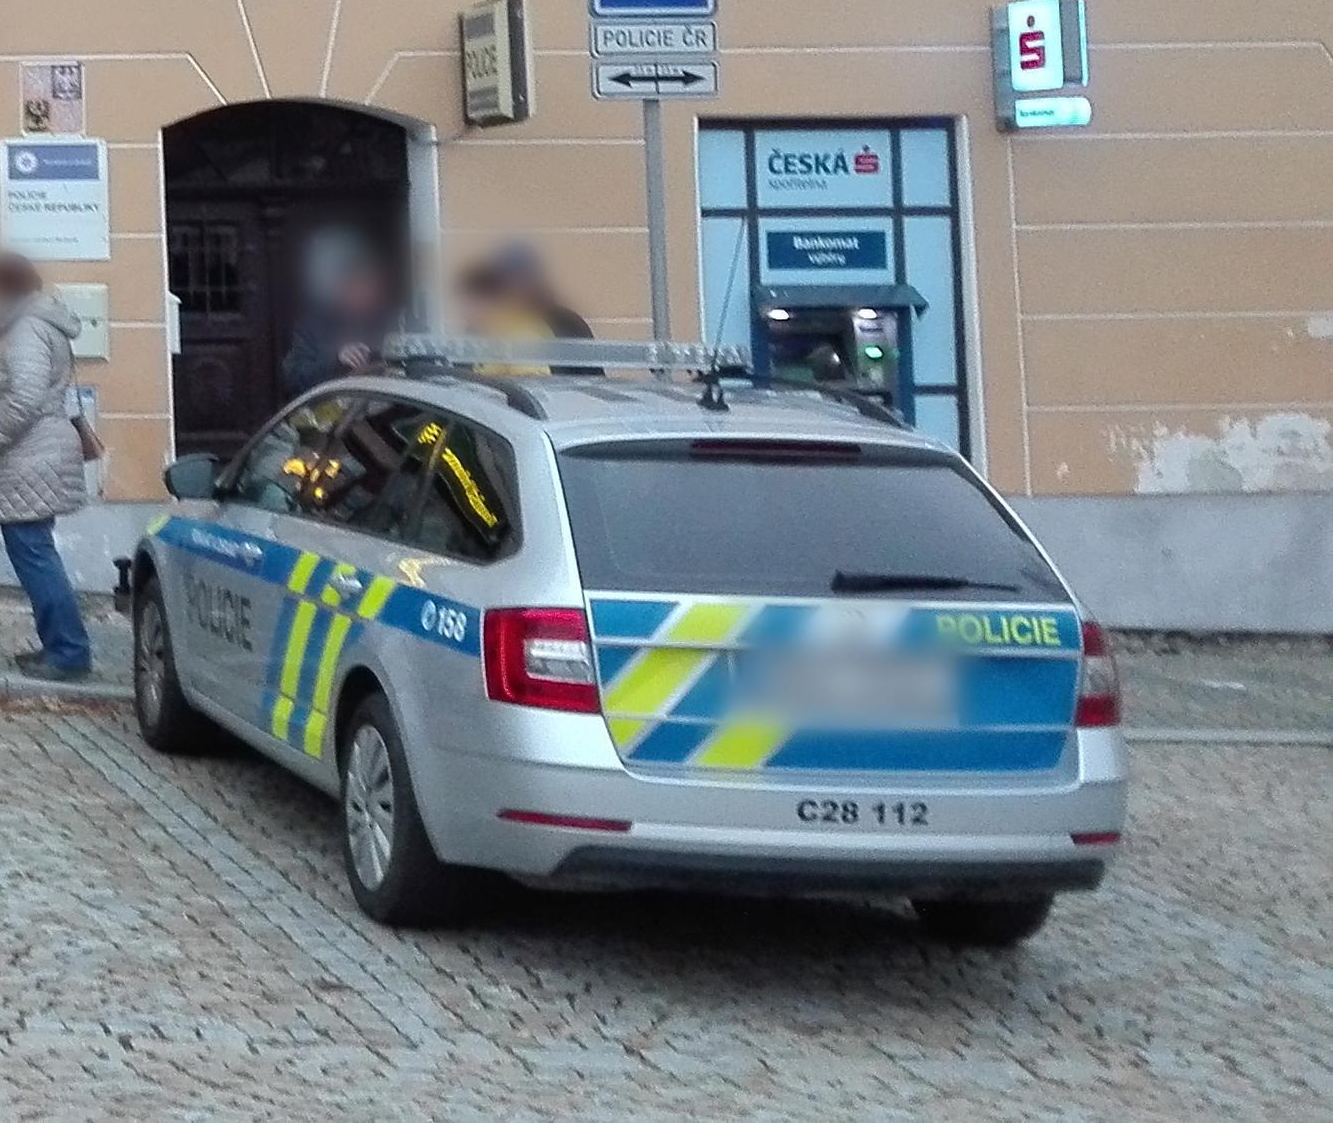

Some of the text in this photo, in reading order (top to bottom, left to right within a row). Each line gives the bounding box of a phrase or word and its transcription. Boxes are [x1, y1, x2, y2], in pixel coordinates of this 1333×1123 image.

[602, 23, 707, 49] POLICIE ČR
[767, 147, 850, 176] ČESKÁ
[792, 235, 861, 251] Bankomat
[436, 607, 468, 643] 158
[937, 615, 1062, 647] POLICIE
[796, 799, 930, 827] C28 112
